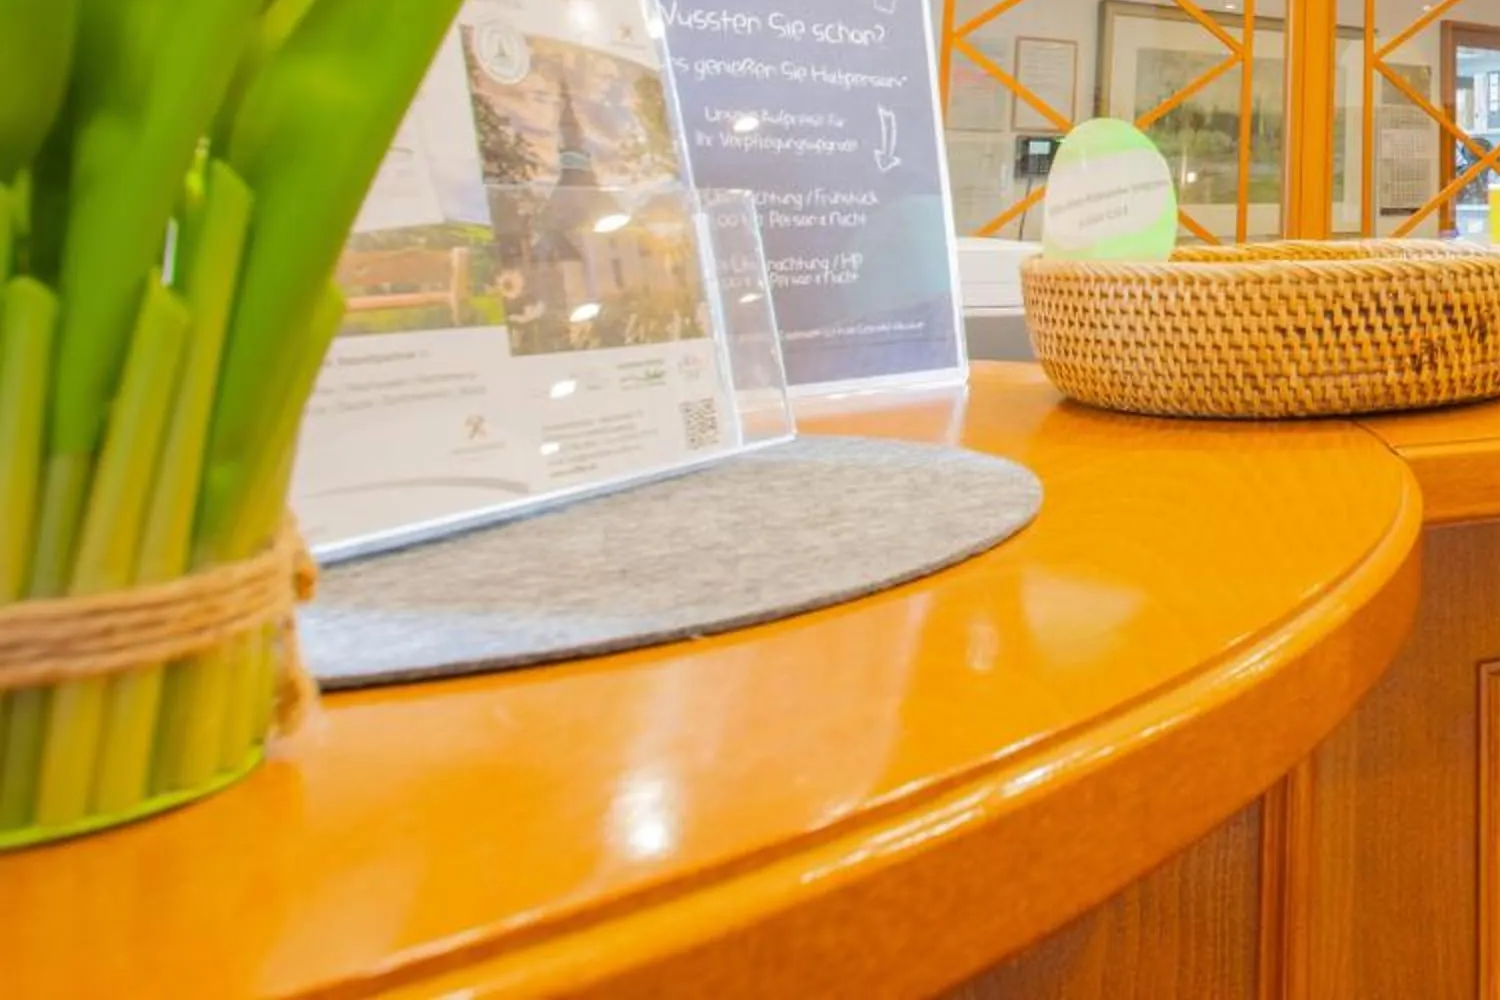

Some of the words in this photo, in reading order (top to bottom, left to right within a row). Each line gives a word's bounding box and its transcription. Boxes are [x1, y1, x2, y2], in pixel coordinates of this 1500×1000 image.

[768, 12, 806, 42] Sie
[812, 20, 886, 47] schon?
[781, 61, 807, 81] Sie
